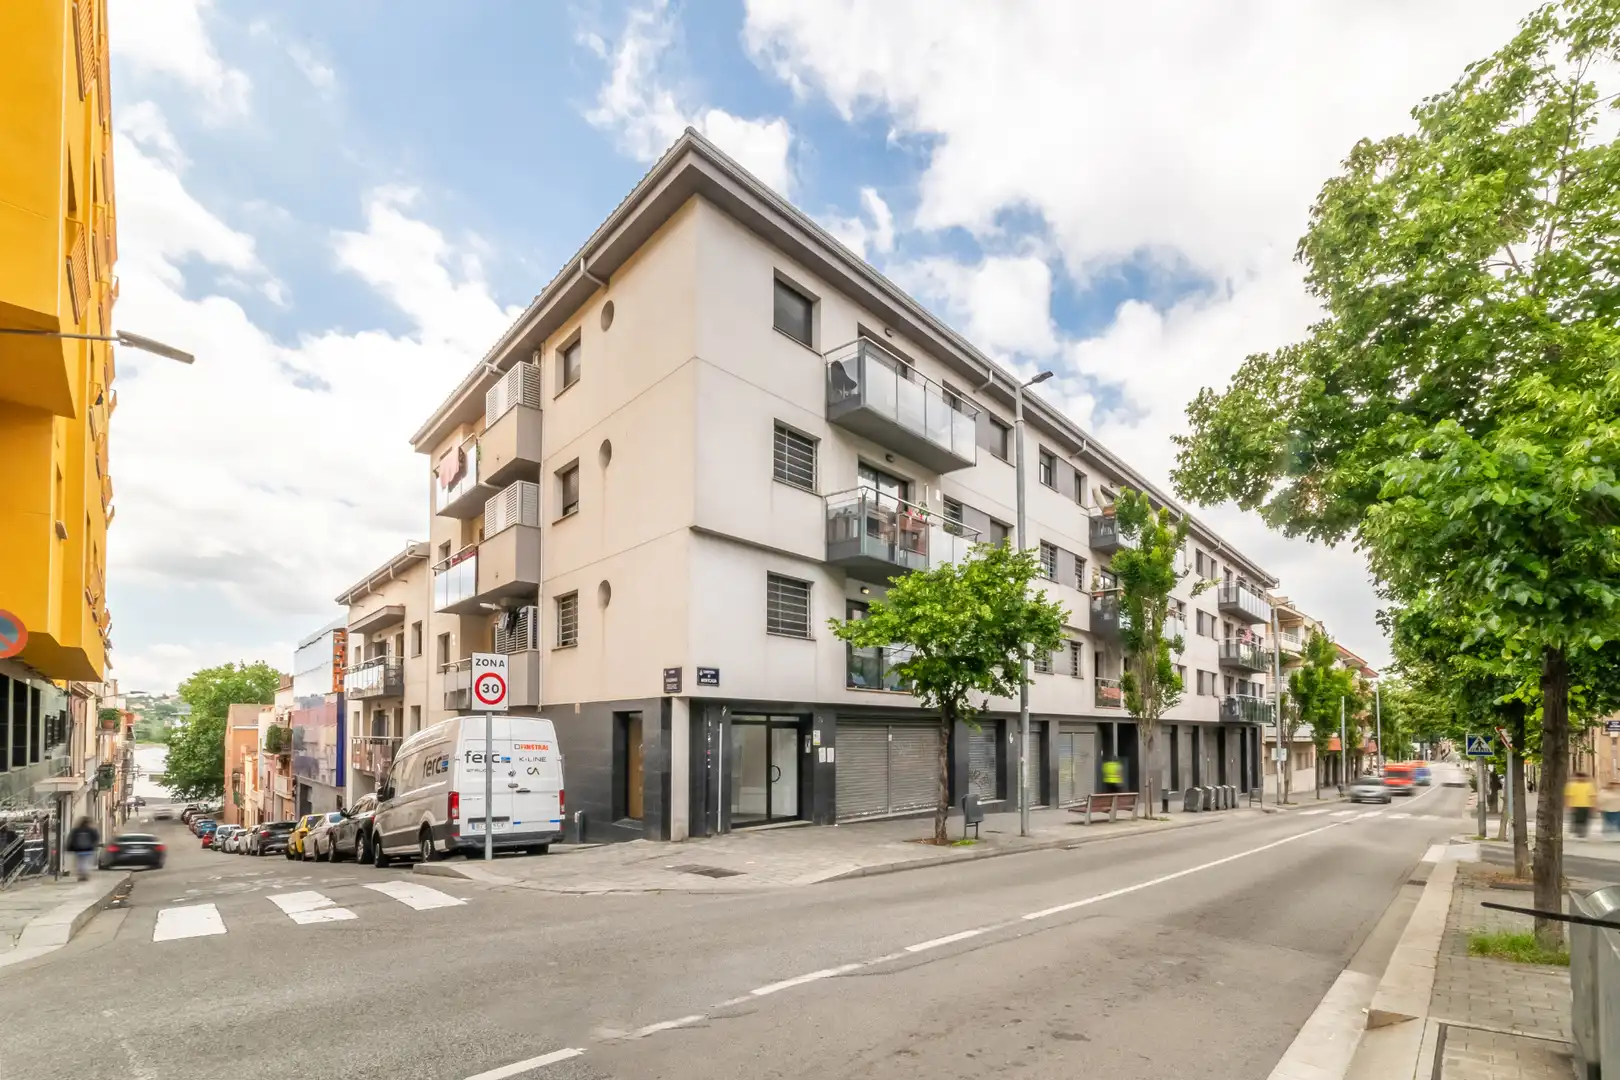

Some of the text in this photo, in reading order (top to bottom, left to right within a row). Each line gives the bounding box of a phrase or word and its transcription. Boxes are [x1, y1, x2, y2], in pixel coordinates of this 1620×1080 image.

[475, 658, 505, 668] ZONA
[482, 683, 499, 694] 30
[423, 756, 442, 778] ferc
